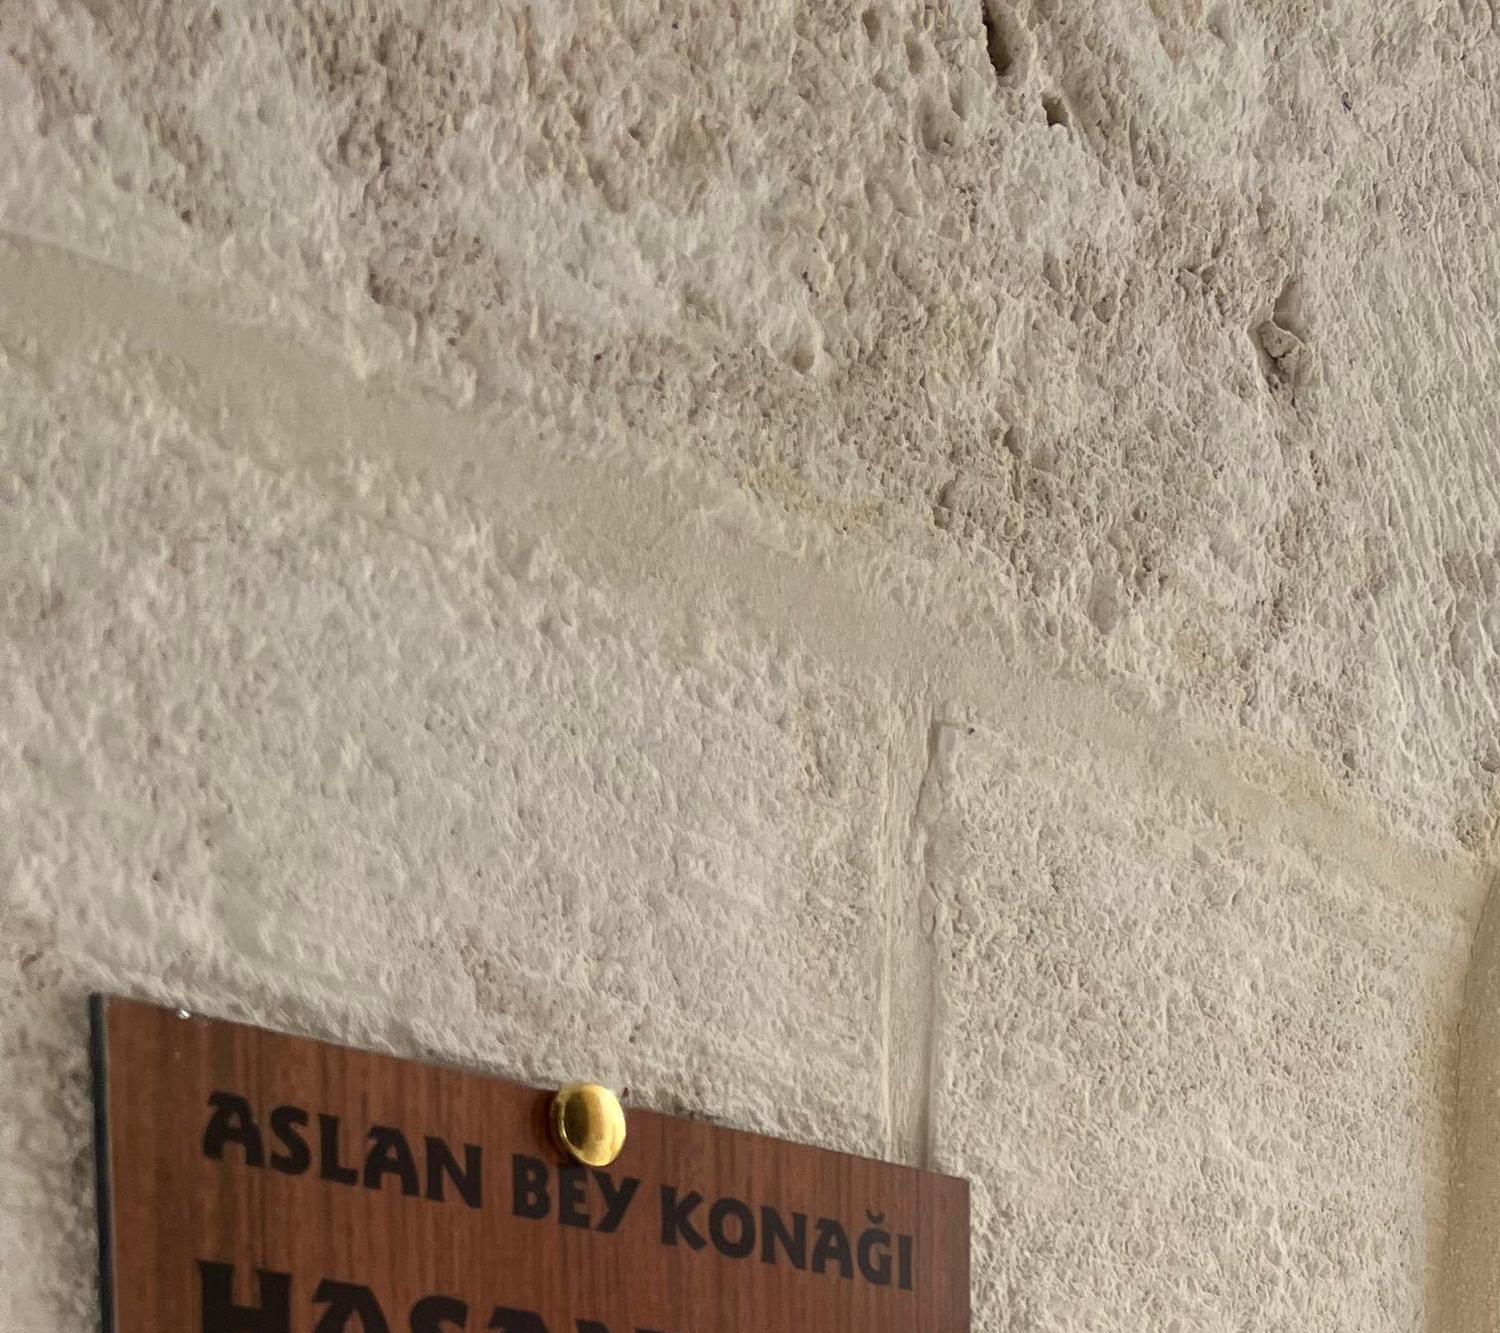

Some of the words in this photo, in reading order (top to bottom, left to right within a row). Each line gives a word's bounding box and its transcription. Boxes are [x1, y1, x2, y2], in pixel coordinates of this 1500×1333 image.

[203, 1091, 483, 1210] ASLAN
[511, 1153, 642, 1234] BEY
[659, 1183, 915, 1291] KONAĞI
